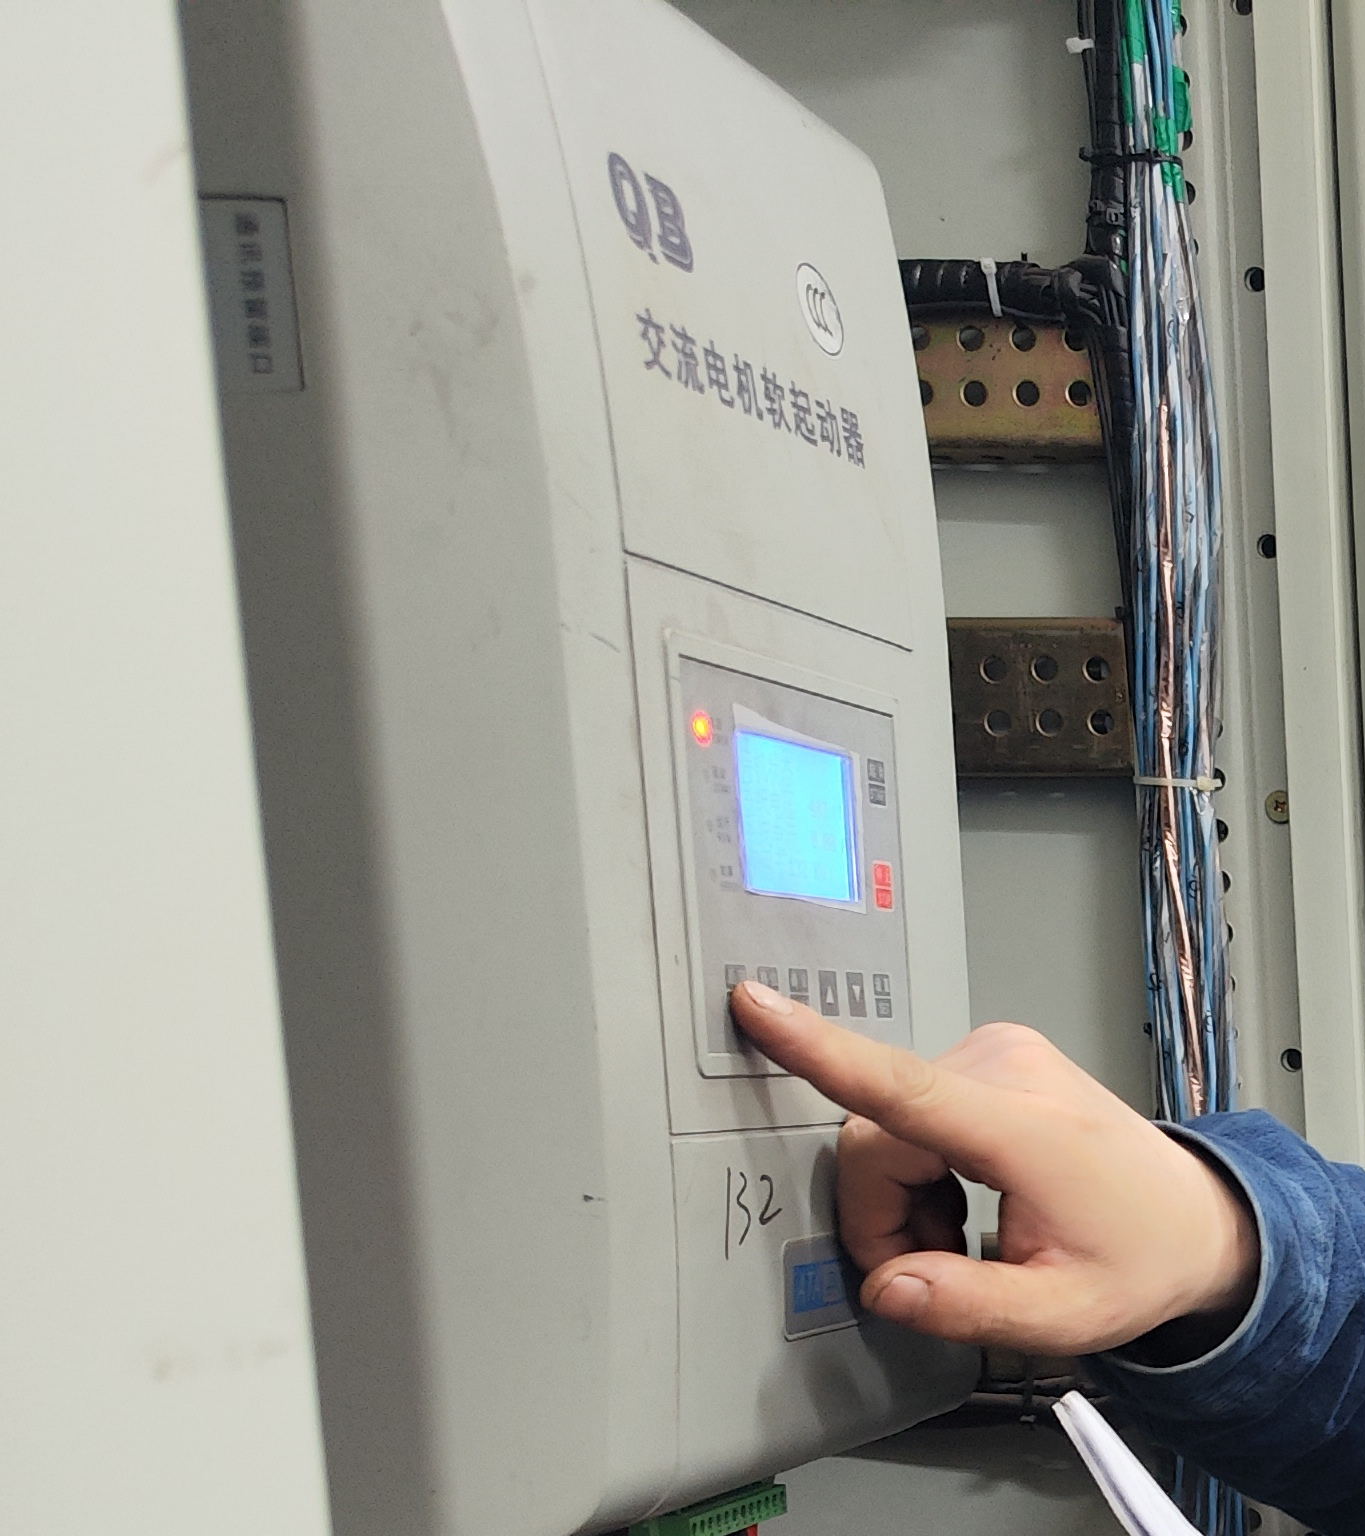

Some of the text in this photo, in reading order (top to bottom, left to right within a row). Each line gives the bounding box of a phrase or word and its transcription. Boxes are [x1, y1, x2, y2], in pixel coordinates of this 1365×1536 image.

[607, 152, 694, 273] QB
[636, 308, 866, 469] 交流电机软起动器
